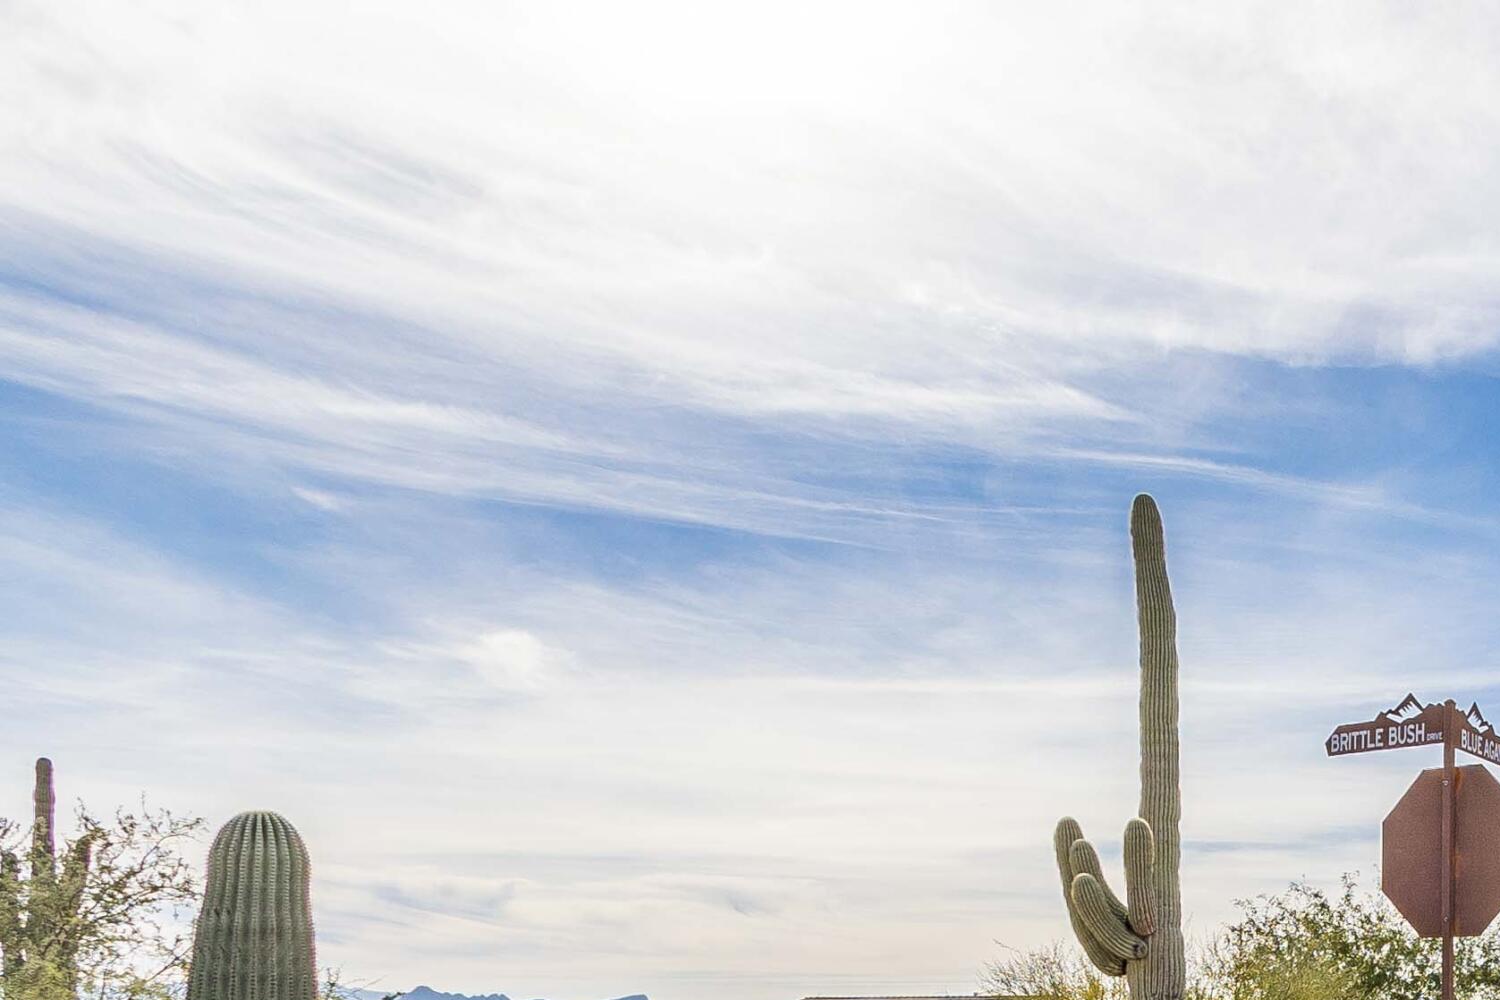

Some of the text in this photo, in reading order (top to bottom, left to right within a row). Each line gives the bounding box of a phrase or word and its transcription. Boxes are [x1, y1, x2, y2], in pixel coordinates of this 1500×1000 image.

[1331, 723, 1443, 753] BRITTLE BUSH DRIVE
[1461, 729, 1483, 756] BLUE
